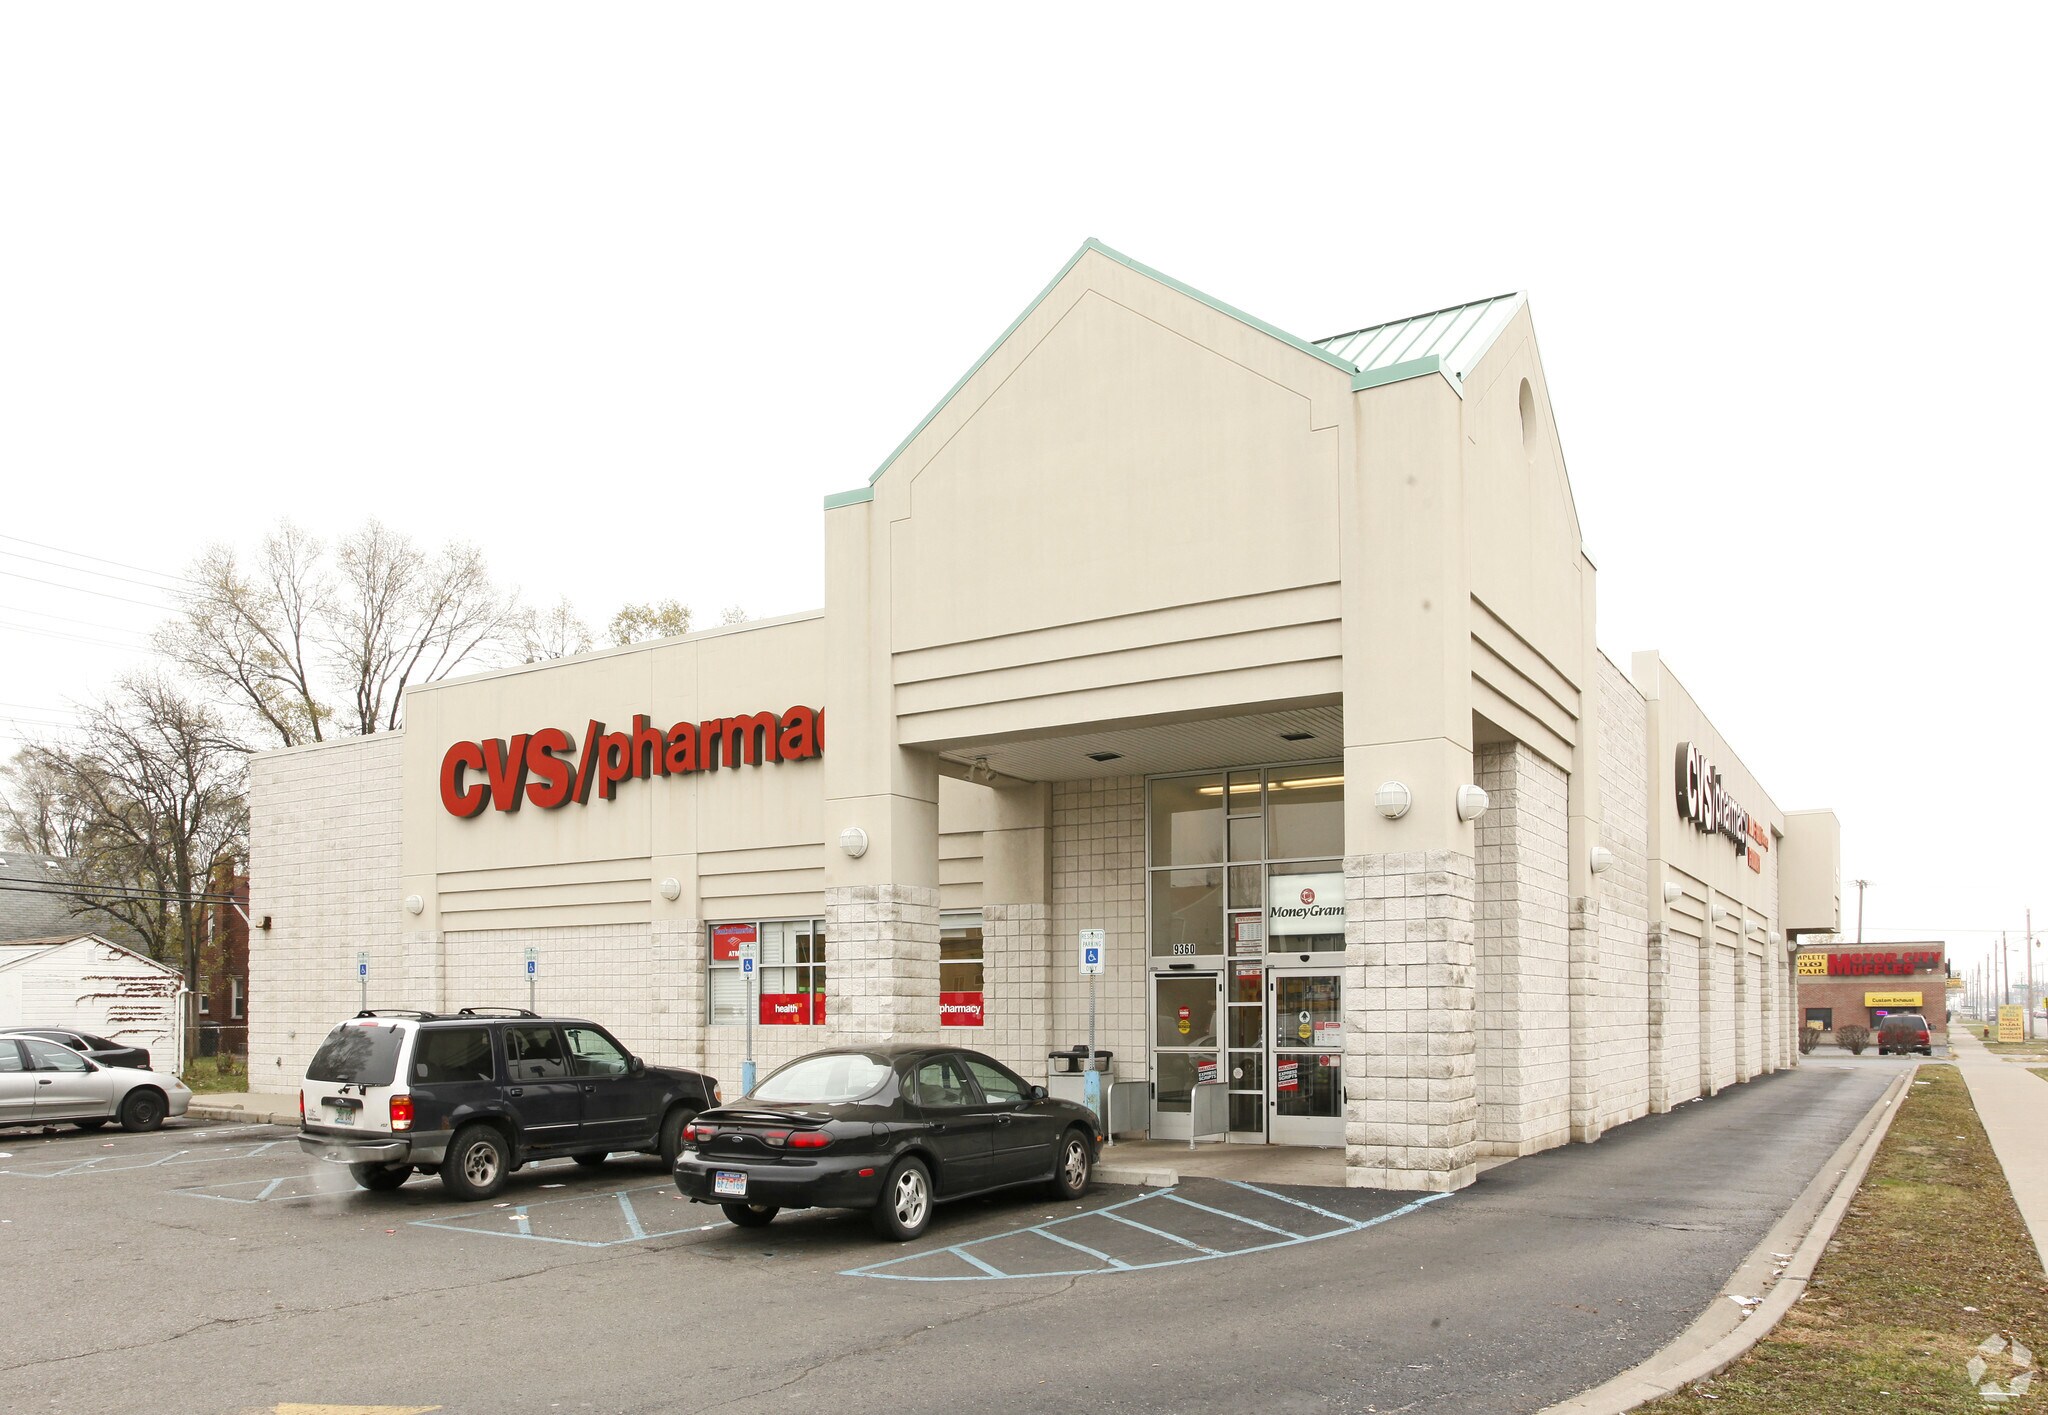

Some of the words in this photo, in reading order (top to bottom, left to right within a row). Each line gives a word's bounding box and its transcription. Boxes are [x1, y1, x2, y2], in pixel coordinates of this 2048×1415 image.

[440, 705, 825, 818] CVS/pharma
[1270, 904, 1345, 920] MoneyGram
[1174, 944, 1195, 955] 9360
[1828, 953, 1897, 972] MOTOR
[1902, 952, 1942, 963] CITY
[1828, 957, 1915, 976] MUFFLER
[775, 1003, 798, 1013] health
[940, 1003, 981, 1015] pharmacy
